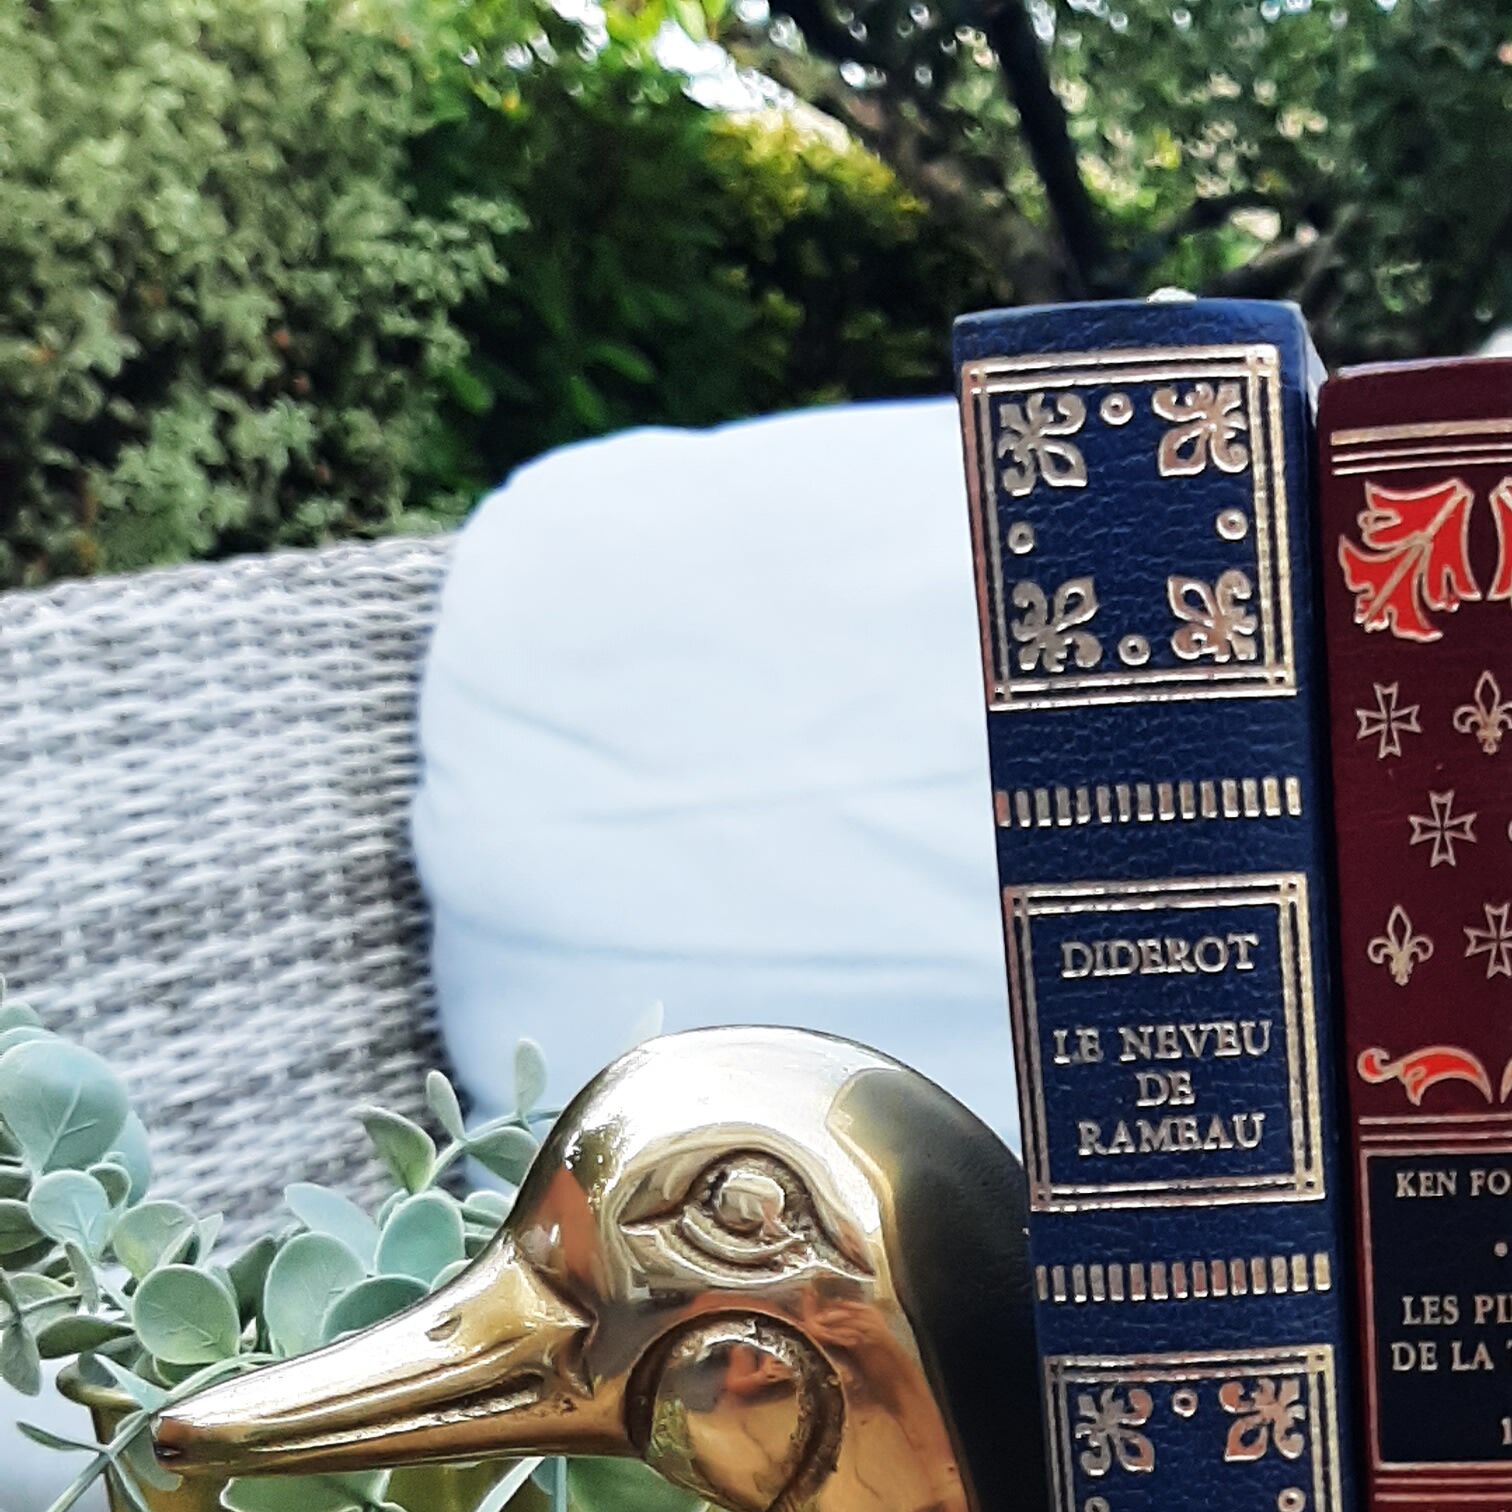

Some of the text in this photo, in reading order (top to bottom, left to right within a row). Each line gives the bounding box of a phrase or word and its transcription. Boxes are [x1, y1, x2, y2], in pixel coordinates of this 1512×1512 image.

[1061, 932, 1260, 979] DIDEROT
[1053, 1020, 1273, 1064] LE NEVEU
[1135, 1071, 1196, 1108] DE
[1077, 1112, 1267, 1156] RAMEAU
[1396, 1170, 1458, 1199] KEN
[1402, 1295, 1460, 1326] LES
[1391, 1341, 1440, 1371] DE
[1450, 1341, 1495, 1372] LA
